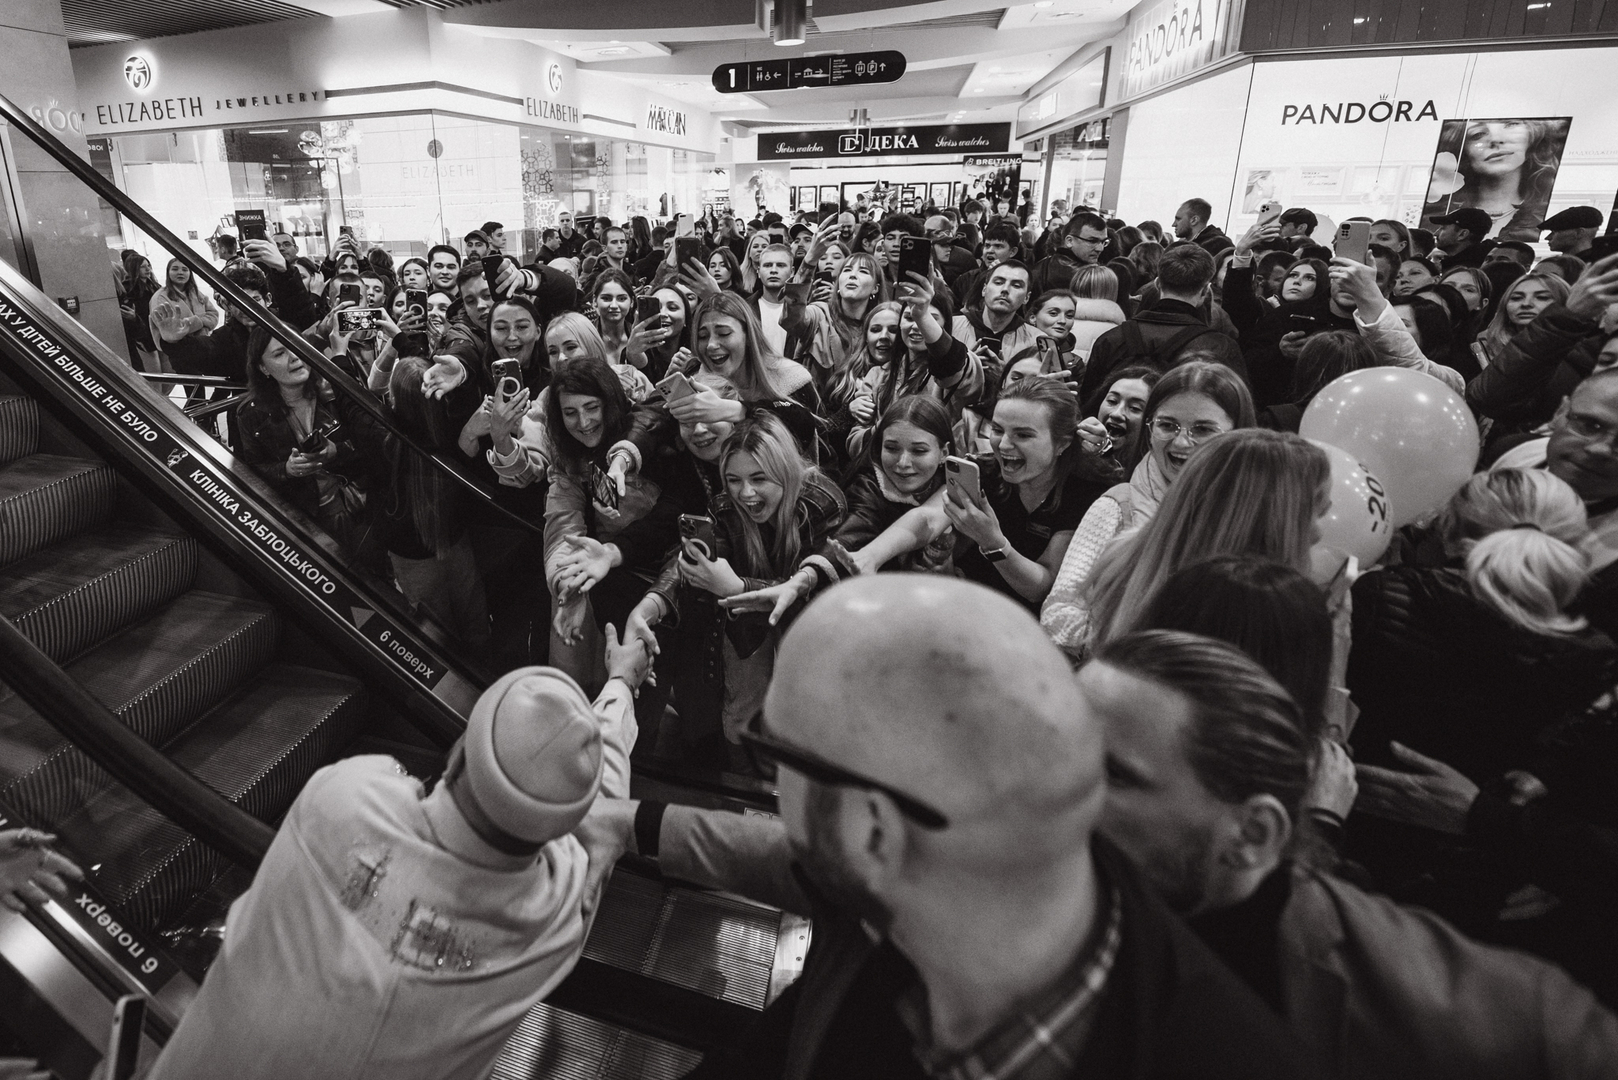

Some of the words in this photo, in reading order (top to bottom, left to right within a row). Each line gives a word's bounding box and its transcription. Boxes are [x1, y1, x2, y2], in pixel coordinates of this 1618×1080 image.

[1129, 0, 1202, 75] PANDORA
[729, 68, 736, 88] 1
[96, 97, 203, 125] ELIZABETH
[215, 91, 318, 110] JEWELLERY
[526, 97, 579, 124] ELIZABETH
[1281, 95, 1438, 125] PANDORA
[775, 141, 796, 154] Swiss
[796, 143, 824, 153] watches
[869, 134, 919, 152] ДЕКА
[935, 135, 957, 148] Swiss
[958, 134, 990, 147] watches
[975, 157, 1022, 165] BREITLING
[10, 316, 27, 325] У
[17, 325, 63, 358] ДІТЕЙ
[54, 354, 107, 398] БІЛЬШЕ
[102, 395, 125, 414] НЕ
[120, 411, 158, 442] БУЛО
[189, 469, 241, 515] КЛІНІКА
[238, 511, 336, 595] ЗАБЛОЦЬКОГО
[379, 630, 392, 643] 6
[389, 638, 434, 680] поверх
[75, 893, 145, 958] поверх
[140, 957, 159, 974] 6
